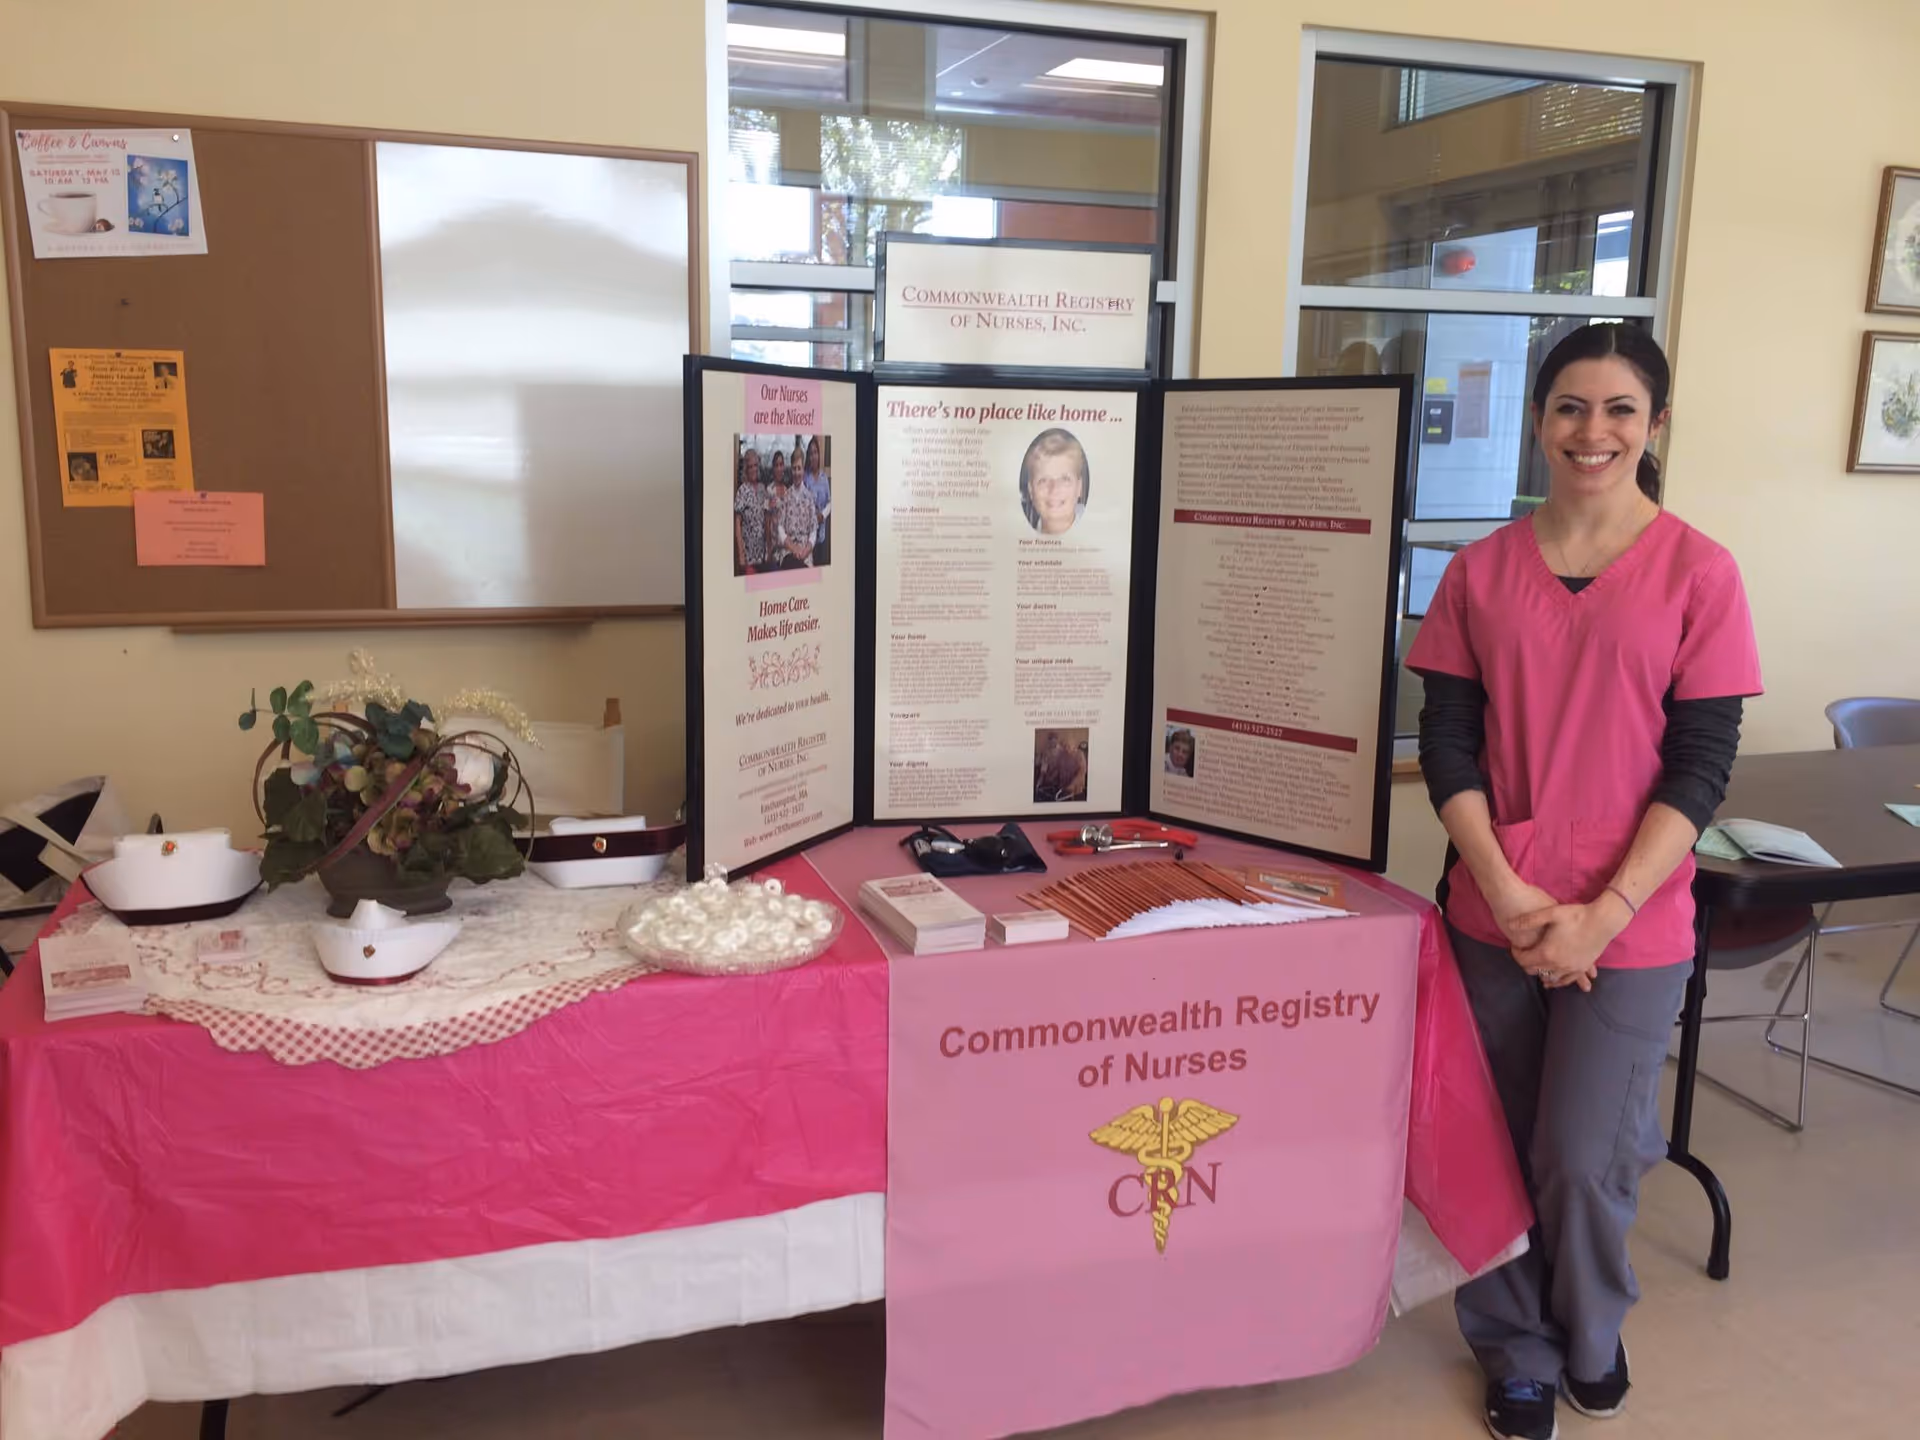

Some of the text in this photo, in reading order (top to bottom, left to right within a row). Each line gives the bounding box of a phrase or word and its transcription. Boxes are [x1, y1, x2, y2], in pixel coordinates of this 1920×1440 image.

[21, 132, 64, 152] Coffee
[902, 286, 1135, 311] COMMONWEALTH REGISTRY
[950, 312, 1087, 332] OF NURSES, INC.
[761, 384, 808, 403] Our Nurses
[754, 407, 815, 426] are the Nicest!
[887, 401, 950, 420] There's
[954, 406, 976, 419] no
[979, 403, 1023, 423] place
[1027, 404, 1056, 421] like
[760, 596, 810, 617] Home Care.
[747, 614, 820, 643] Makes life easier.
[736, 712, 755, 727] We're
[756, 701, 787, 720] dedicated
[788, 702, 795, 712] to
[810, 690, 831, 706] health.
[940, 989, 1380, 1058] Commonwealth Registry
[1078, 1047, 1248, 1088] of Nurses
[1108, 1162, 1222, 1217] CRN
